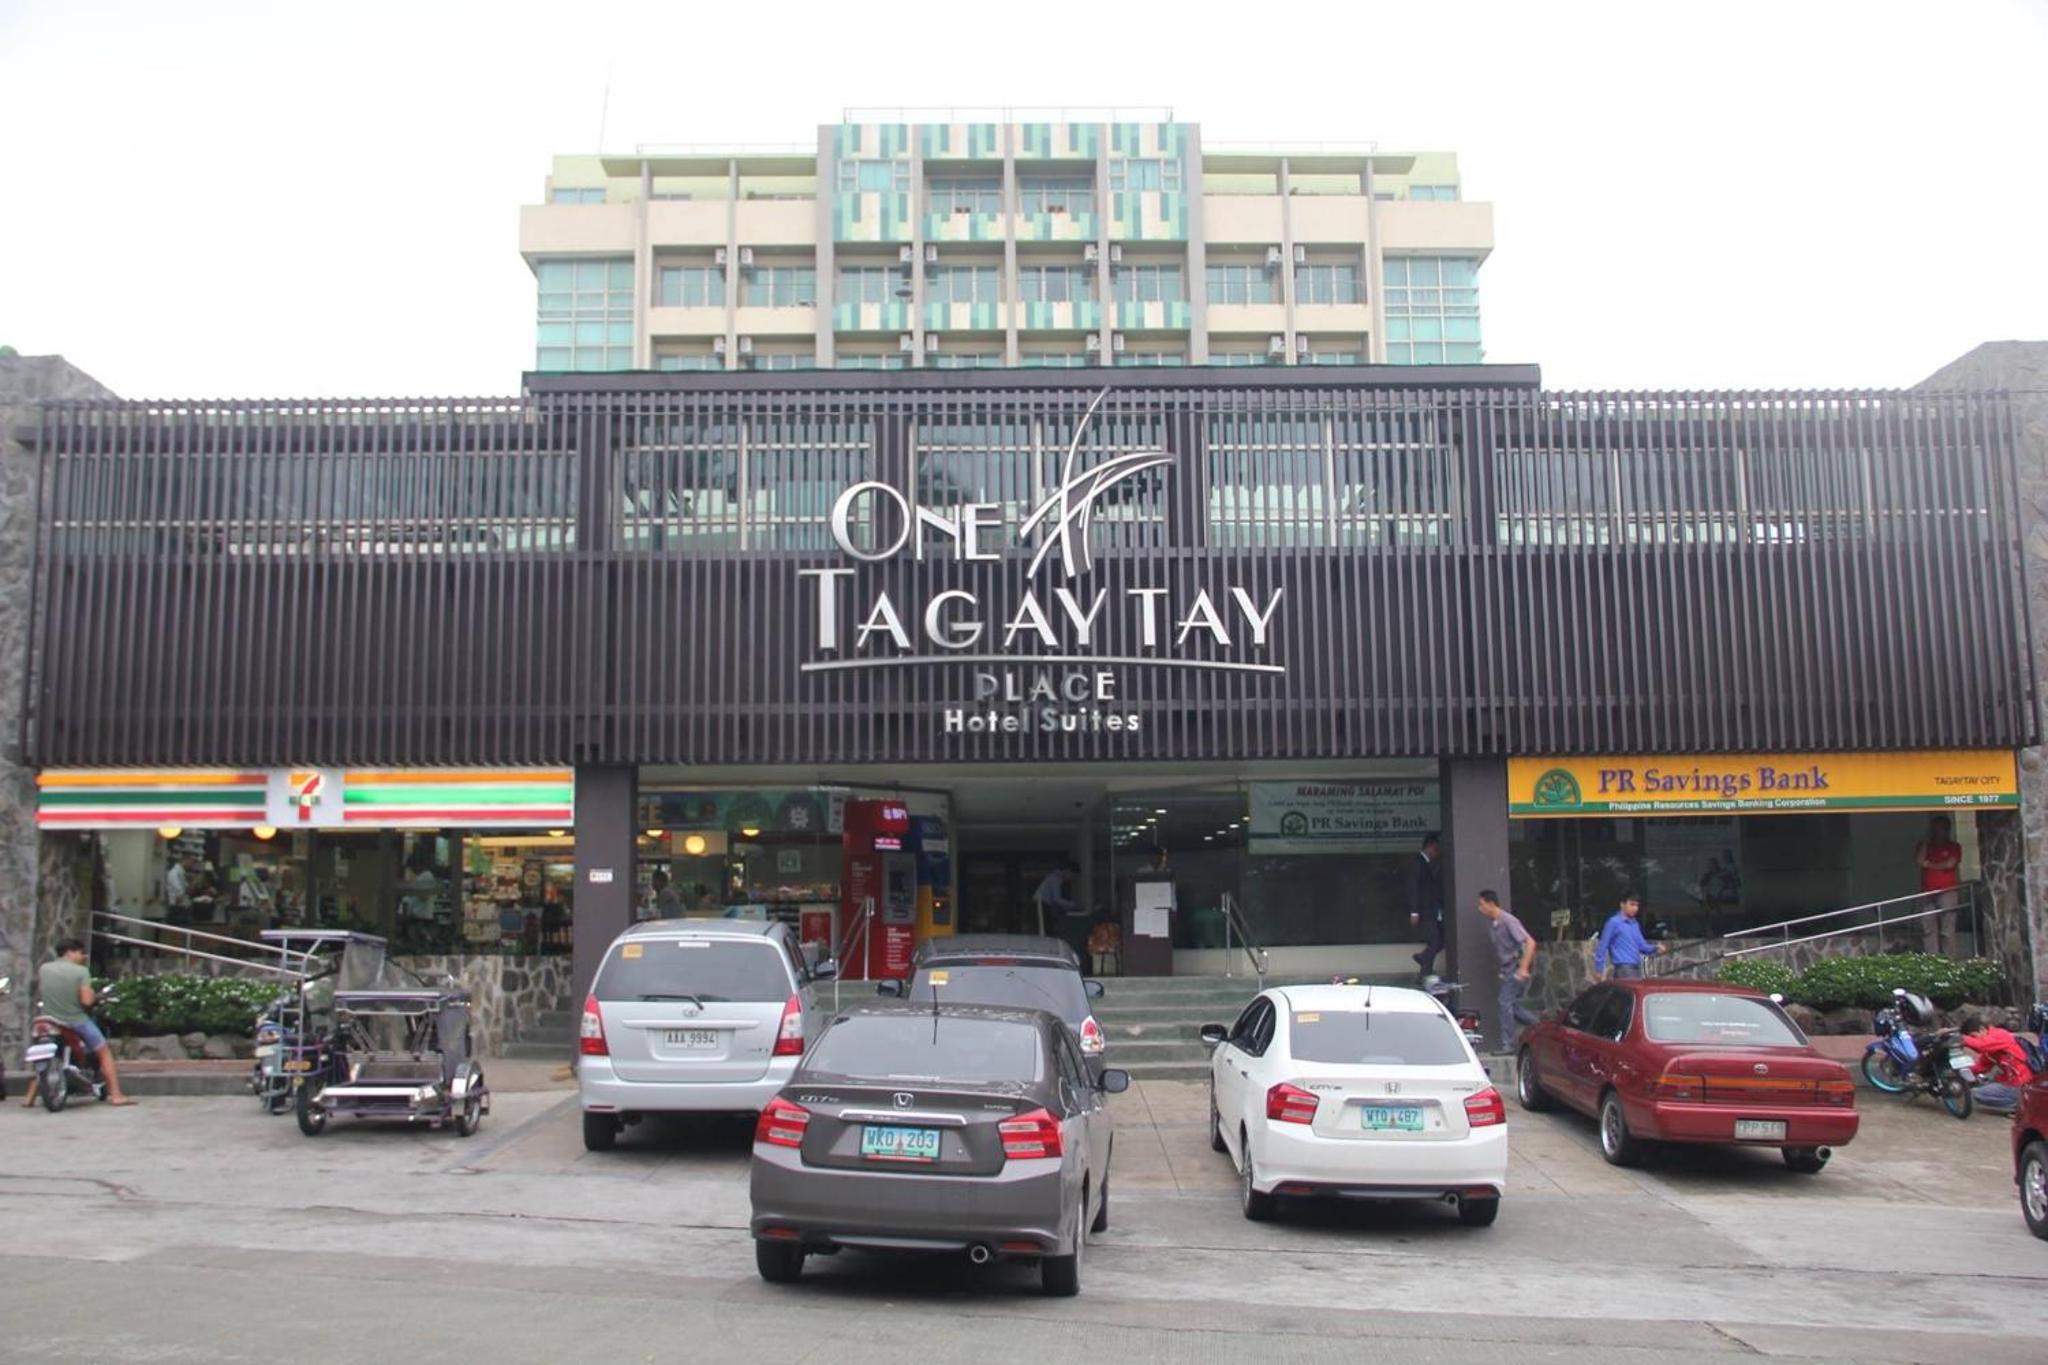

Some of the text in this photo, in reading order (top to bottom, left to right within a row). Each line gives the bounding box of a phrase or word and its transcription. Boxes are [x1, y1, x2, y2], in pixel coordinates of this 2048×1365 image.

[832, 480, 1002, 562] ONE
[798, 566, 1284, 651] TAGAYTAY
[974, 672, 1117, 703] PLACE
[945, 707, 1139, 734] Hotel Suites
[1598, 765, 1829, 797] PR Savings Bank
[1935, 776, 2001, 786] TAGAYTAY CITY
[1296, 786, 1354, 797] MARAMING
[1358, 786, 1405, 797] SALAMAT
[1944, 794, 2000, 804] SINCE 1977
[1608, 796, 1827, 812] Philippine Resources Savings Banking Corporation
[1312, 816, 1428, 832] PR Savings Bank
[907, 1132, 935, 1149] 203
